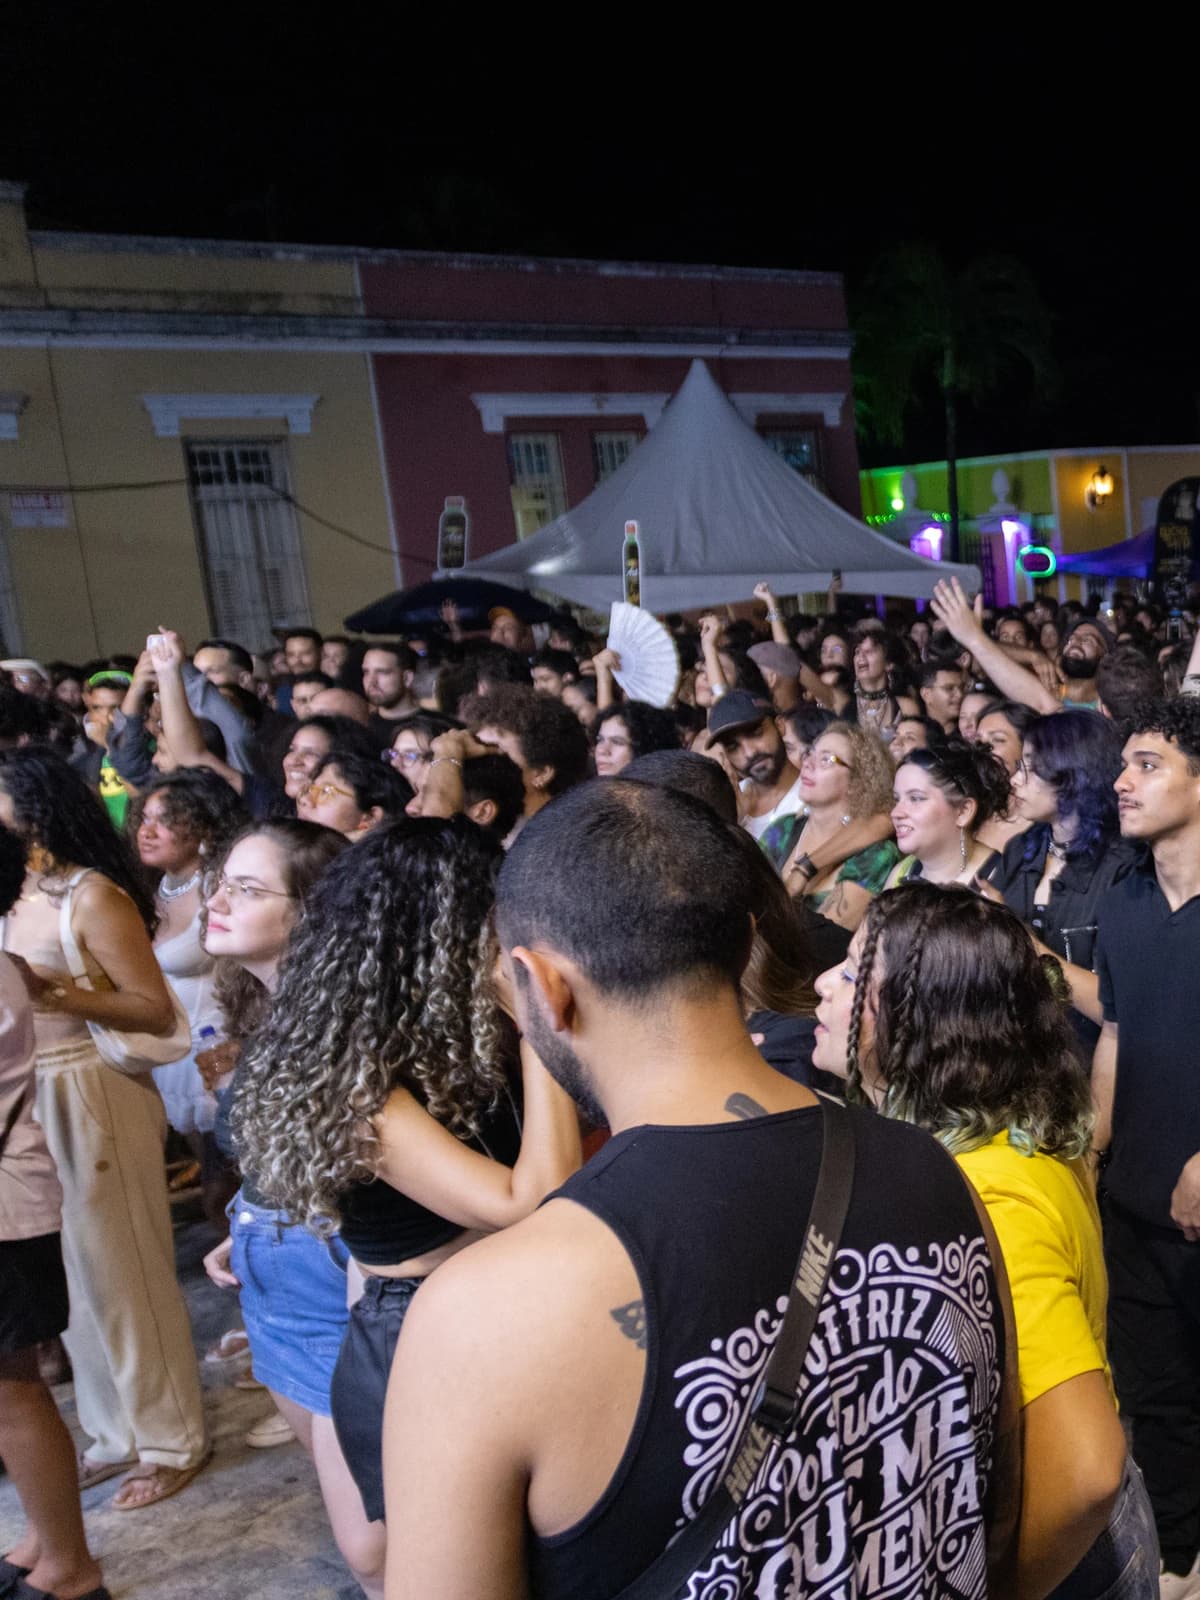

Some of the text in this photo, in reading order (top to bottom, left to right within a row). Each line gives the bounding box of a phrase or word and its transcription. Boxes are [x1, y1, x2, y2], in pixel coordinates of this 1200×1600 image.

[793, 1224, 835, 1307] NIKE
[831, 1348, 922, 1446] Tudo
[879, 1389, 973, 1510] ME
[829, 1458, 980, 1600] MENTA
